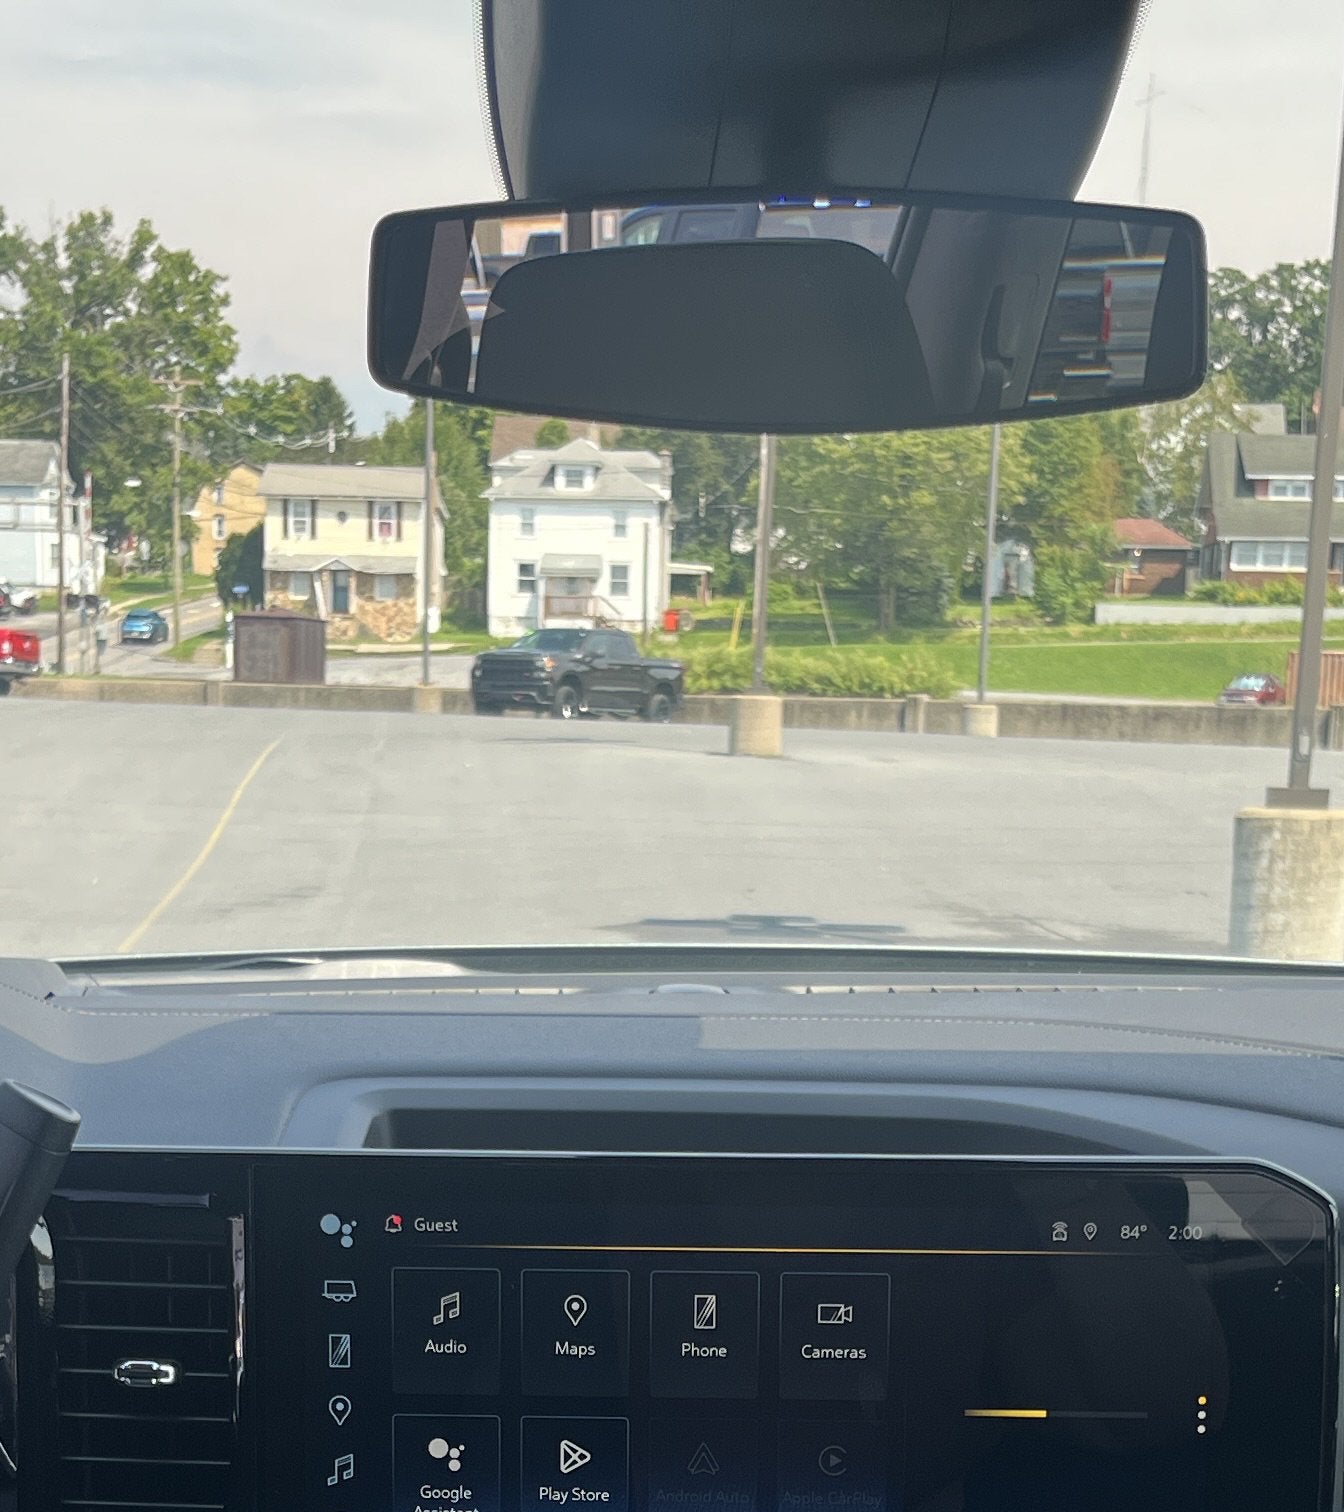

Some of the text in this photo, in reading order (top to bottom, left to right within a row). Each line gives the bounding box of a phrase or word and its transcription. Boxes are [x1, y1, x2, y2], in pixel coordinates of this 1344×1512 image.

[414, 1216, 459, 1234] Guest
[1120, 1224, 1203, 1241] 84° 2:00
[424, 1339, 467, 1354] Audio
[555, 1341, 596, 1359] Maps
[681, 1343, 728, 1358] Phone
[801, 1344, 867, 1360] Cameras
[420, 1485, 472, 1502] Google
[539, 1487, 610, 1505] Play Store
